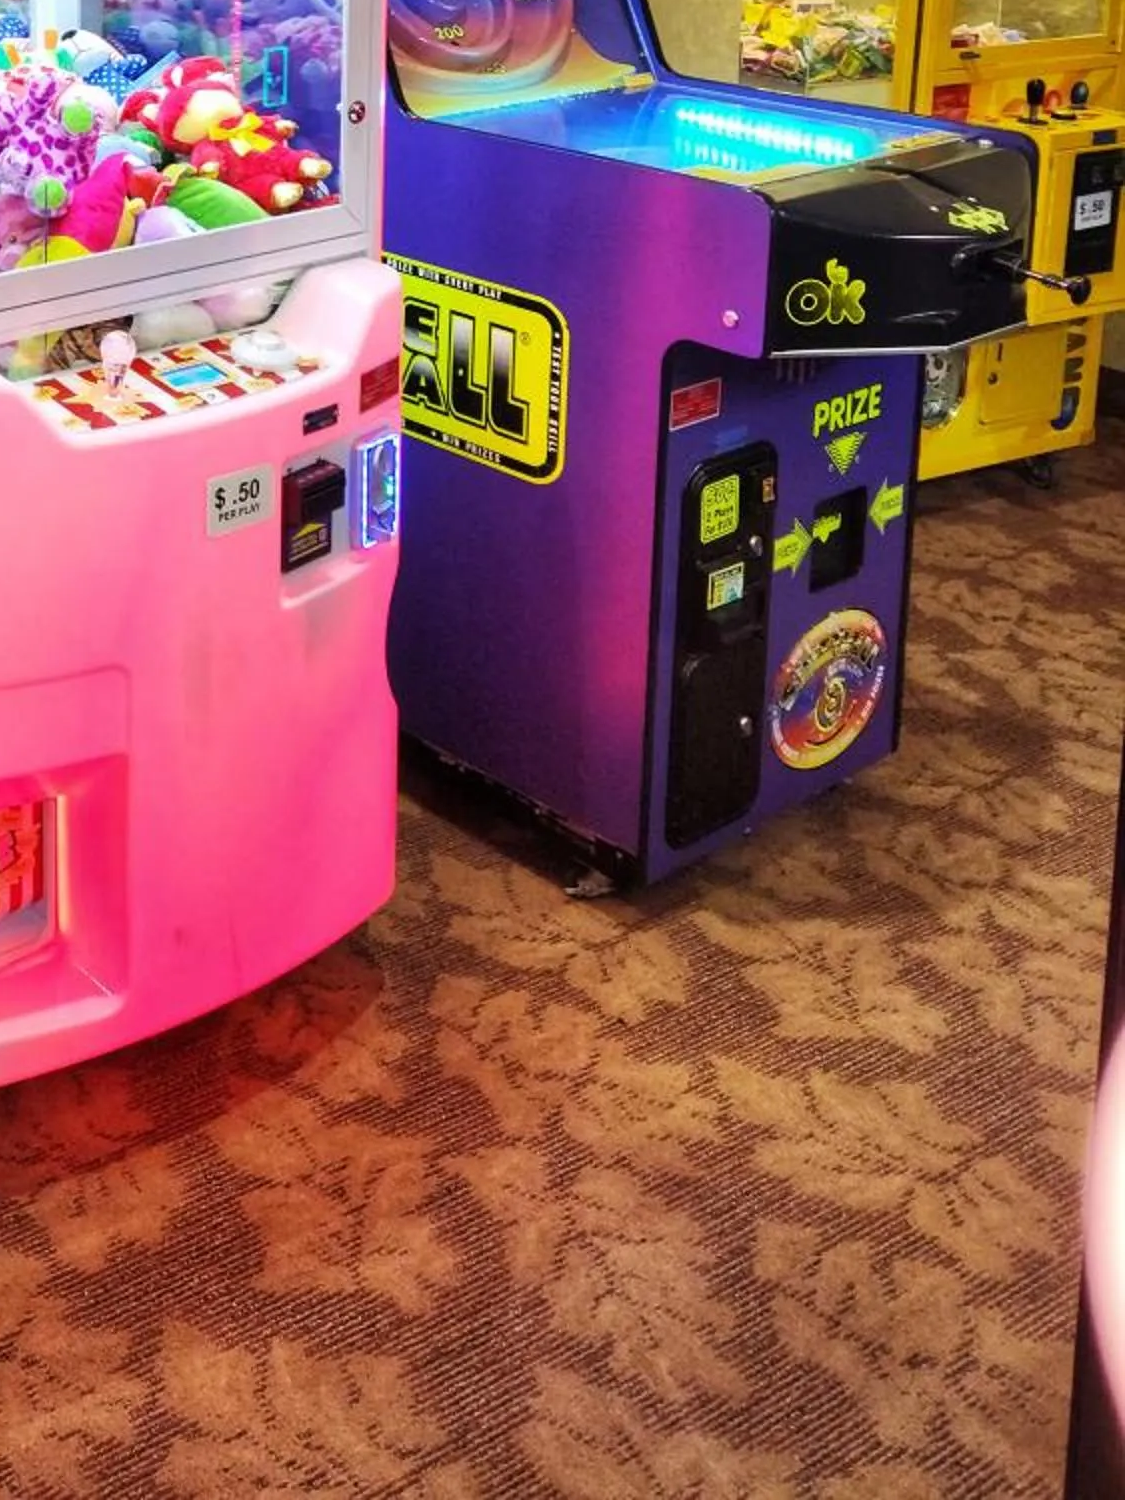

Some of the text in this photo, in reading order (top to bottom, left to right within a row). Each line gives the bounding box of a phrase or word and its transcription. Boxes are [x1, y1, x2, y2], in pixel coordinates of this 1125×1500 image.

[785, 265, 865, 326] OK
[548, 345, 562, 453] TEST YOUR SKILL
[812, 383, 883, 438] PRIZE
[214, 478, 260, 511] $ .50
[218, 502, 260, 523] PER PLAY
